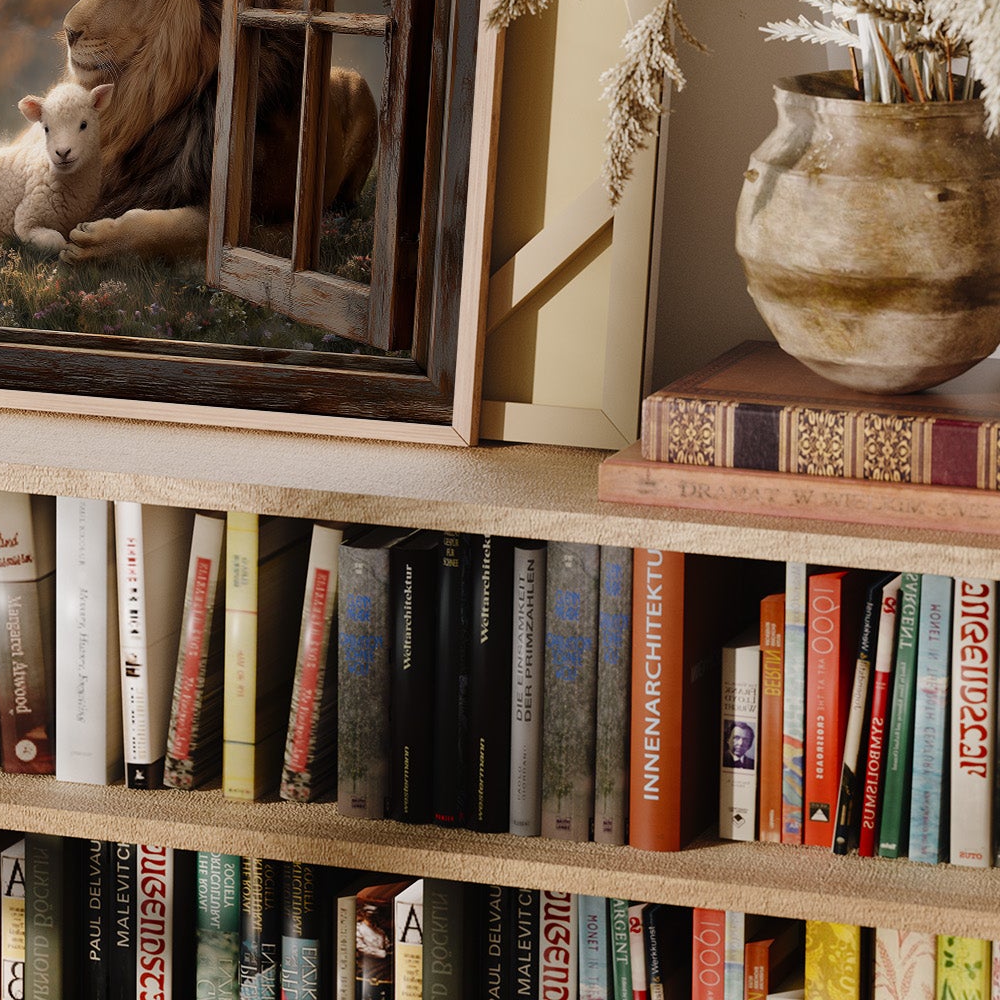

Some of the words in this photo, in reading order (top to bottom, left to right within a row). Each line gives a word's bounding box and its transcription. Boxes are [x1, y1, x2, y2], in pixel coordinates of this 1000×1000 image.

[6, 595, 26, 658] Margaret
[403, 563, 412, 670] Weltarchitektur
[517, 574, 526, 685] EINSAMKEIT
[525, 559, 535, 675] PRIMZAHLEN
[12, 660, 33, 714] Atwood
[516, 690, 524, 722] DIE
[524, 687, 533, 722] DER
[644, 549, 664, 801] INNENARCHITEKTU
[477, 737, 485, 820] westermann
[89, 840, 101, 910] DELVAU
[89, 916, 101, 961] PAUL
[399, 903, 423, 942] A
[490, 884, 502, 956] DELVAU
[586, 914, 598, 951] MONET
[649, 926, 660, 975] Werkkunst
[694, 921, 721, 986] 1900
